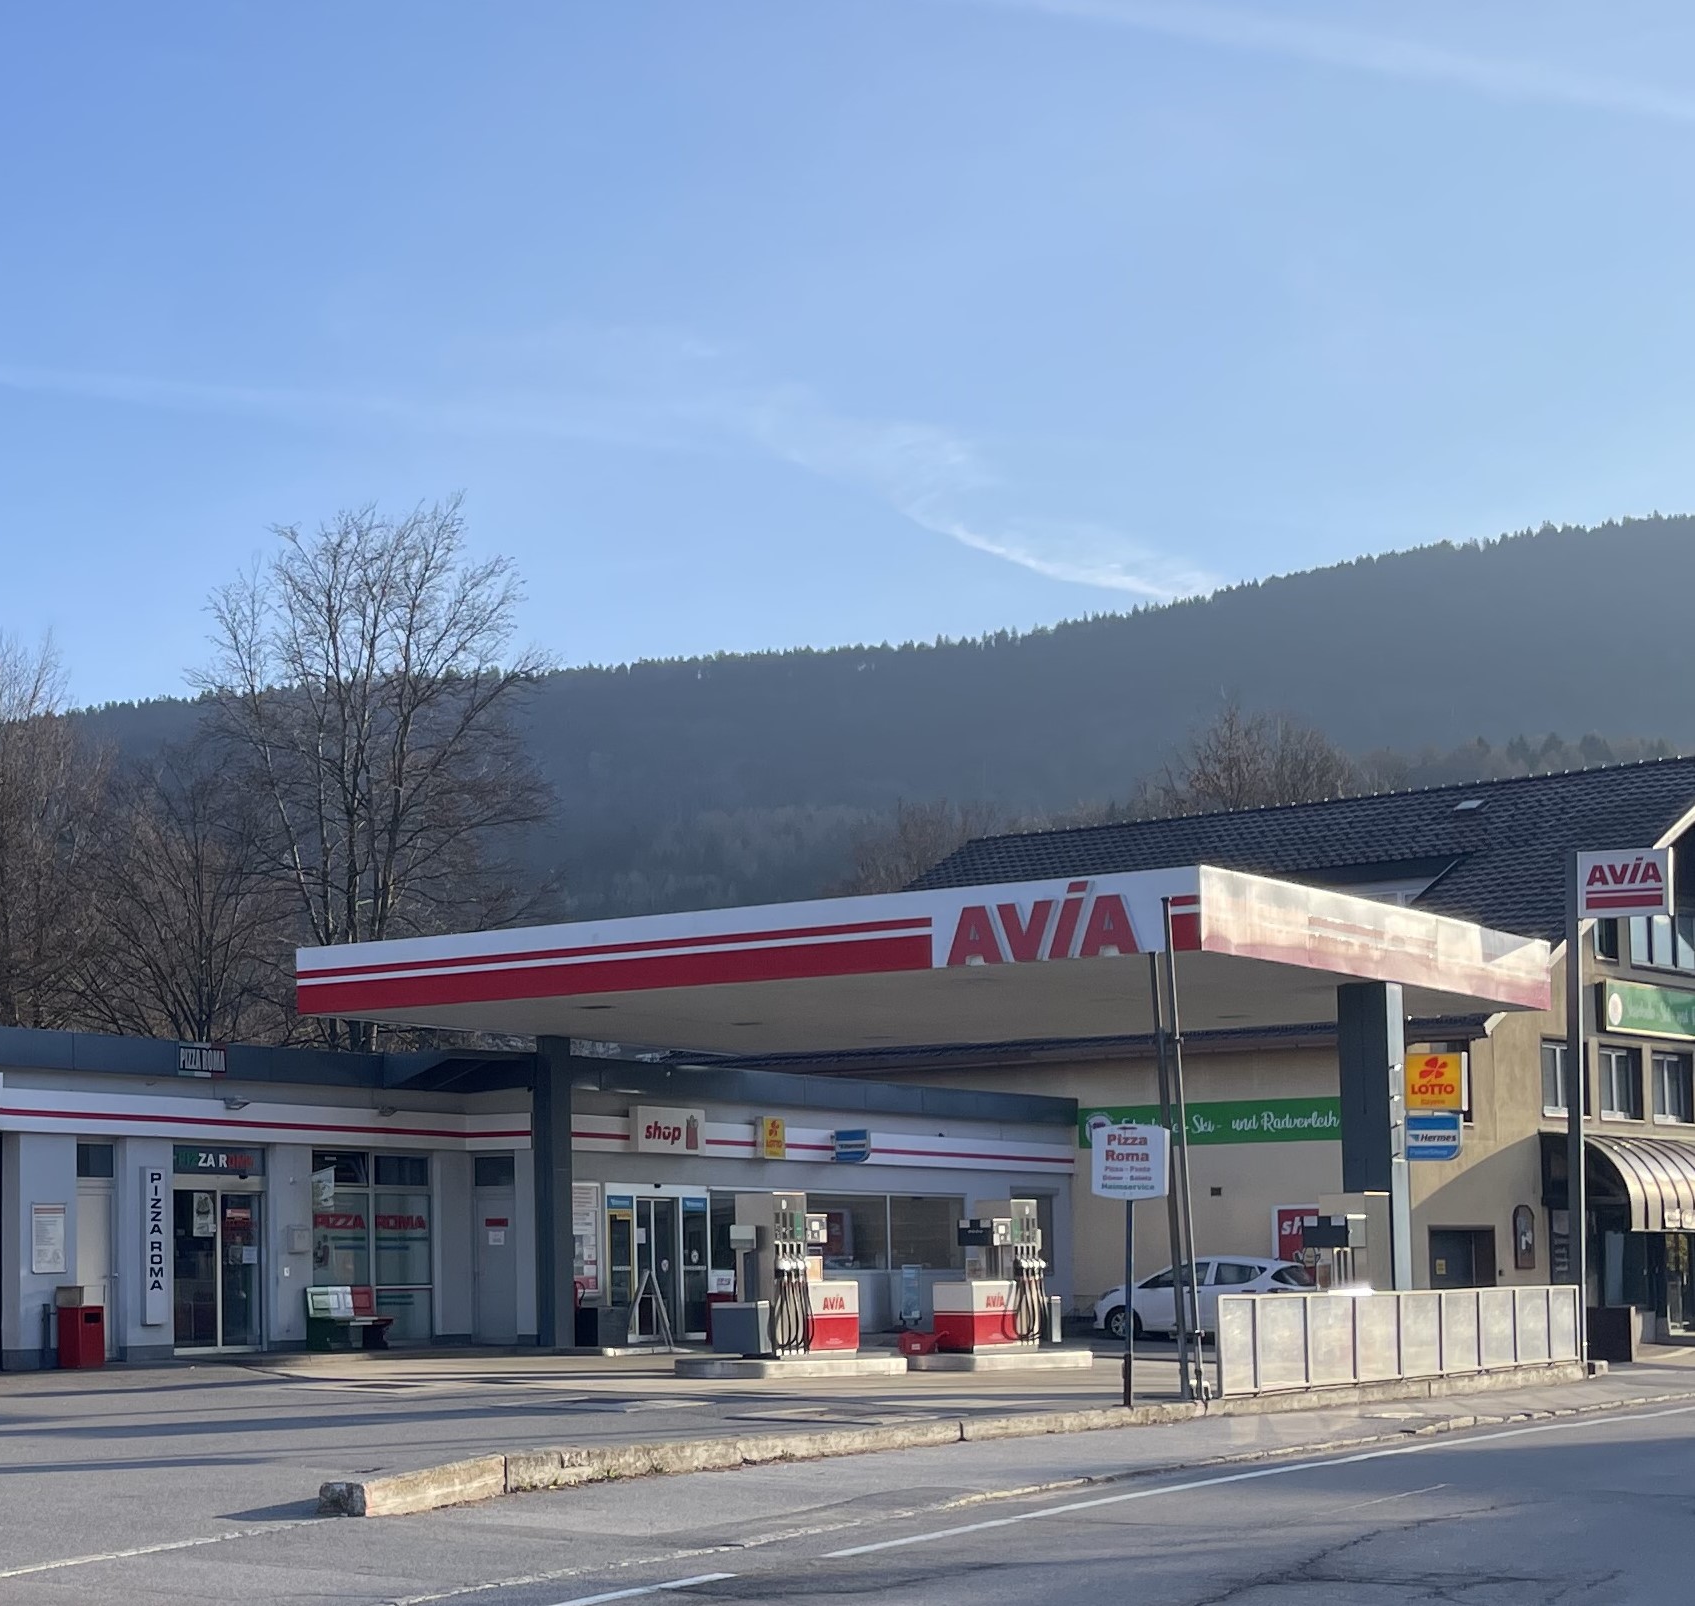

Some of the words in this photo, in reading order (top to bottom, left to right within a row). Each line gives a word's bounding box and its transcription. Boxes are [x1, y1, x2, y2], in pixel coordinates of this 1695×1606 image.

[1586, 857, 1663, 887] AVIA
[946, 880, 1142, 966] AVIA
[180, 1048, 202, 1070] PIZZA
[202, 1049, 226, 1072] ROMA
[1411, 1083, 1455, 1095] LOTTO
[1231, 1113, 1259, 1132] und
[1261, 1111, 1339, 1132] Radverleih
[645, 1121, 681, 1146] shop
[1107, 1133, 1149, 1146] Pizza
[1420, 1134, 1457, 1142] Hermes
[1105, 1149, 1150, 1162] Roma
[150, 1172, 163, 1235] PIZZA
[149, 1241, 164, 1291] ROMA
[822, 1293, 845, 1311] AVIA
[985, 1291, 1005, 1309] AVIA
